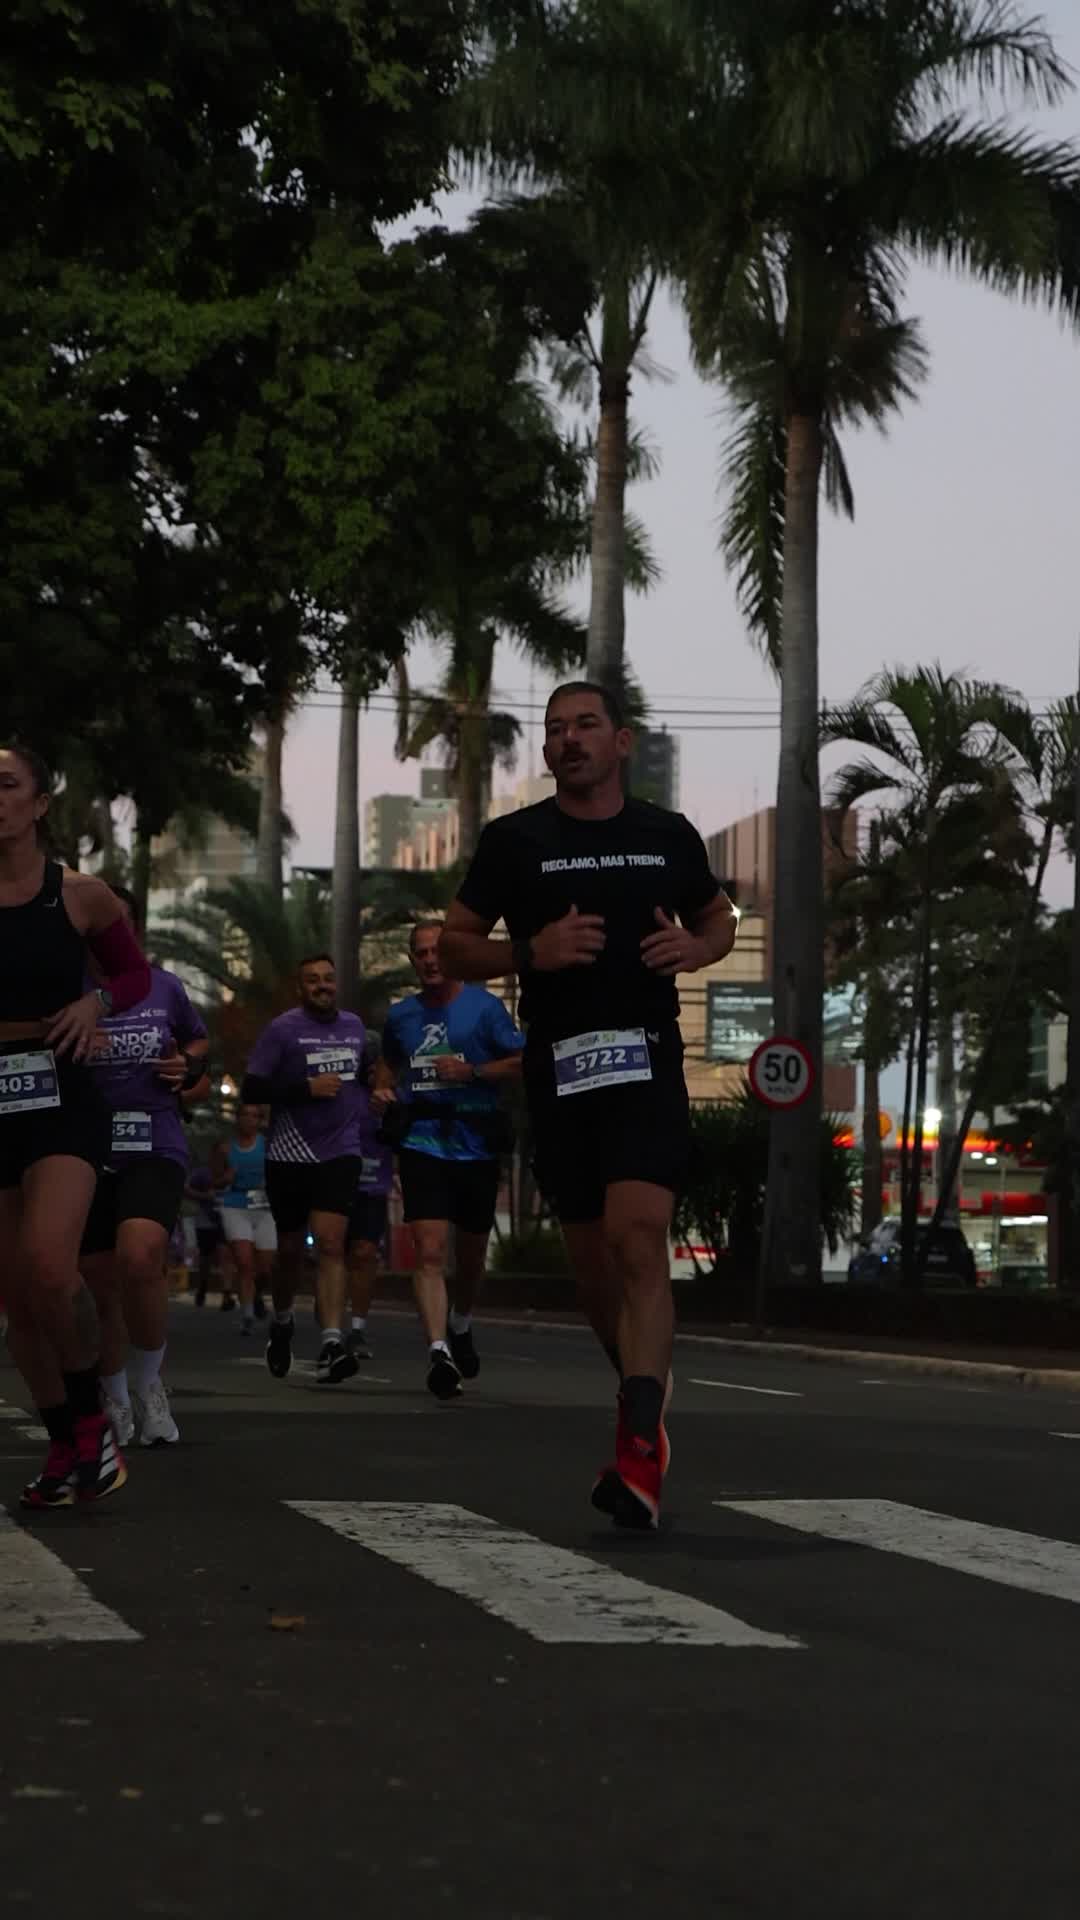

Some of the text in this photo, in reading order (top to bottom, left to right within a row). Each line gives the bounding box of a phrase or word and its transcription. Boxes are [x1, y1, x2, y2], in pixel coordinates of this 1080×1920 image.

[541, 853, 666, 873] RECLAMO, MAS TREINO
[317, 1061, 345, 1073] 6128
[575, 1047, 627, 1073] 5722
[765, 1053, 801, 1083] 50
